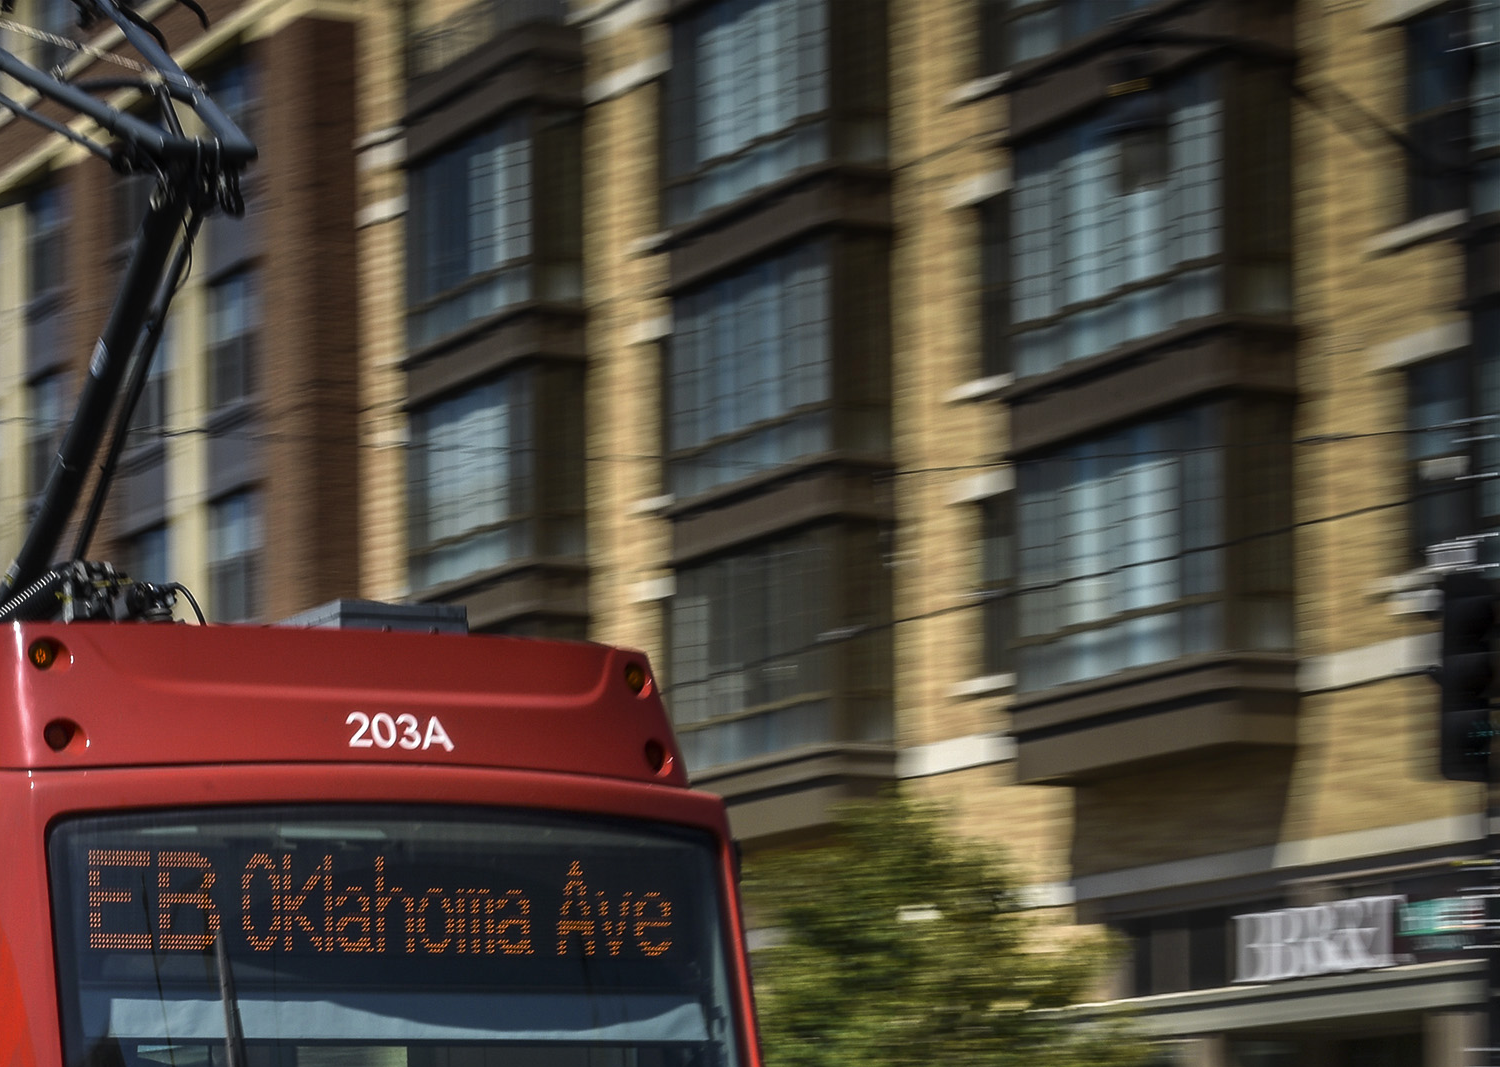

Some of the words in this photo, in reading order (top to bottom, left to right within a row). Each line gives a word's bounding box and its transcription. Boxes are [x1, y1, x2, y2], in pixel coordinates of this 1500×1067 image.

[346, 711, 455, 752] 203A
[89, 850, 221, 950] EB
[556, 860, 673, 956] Ave
